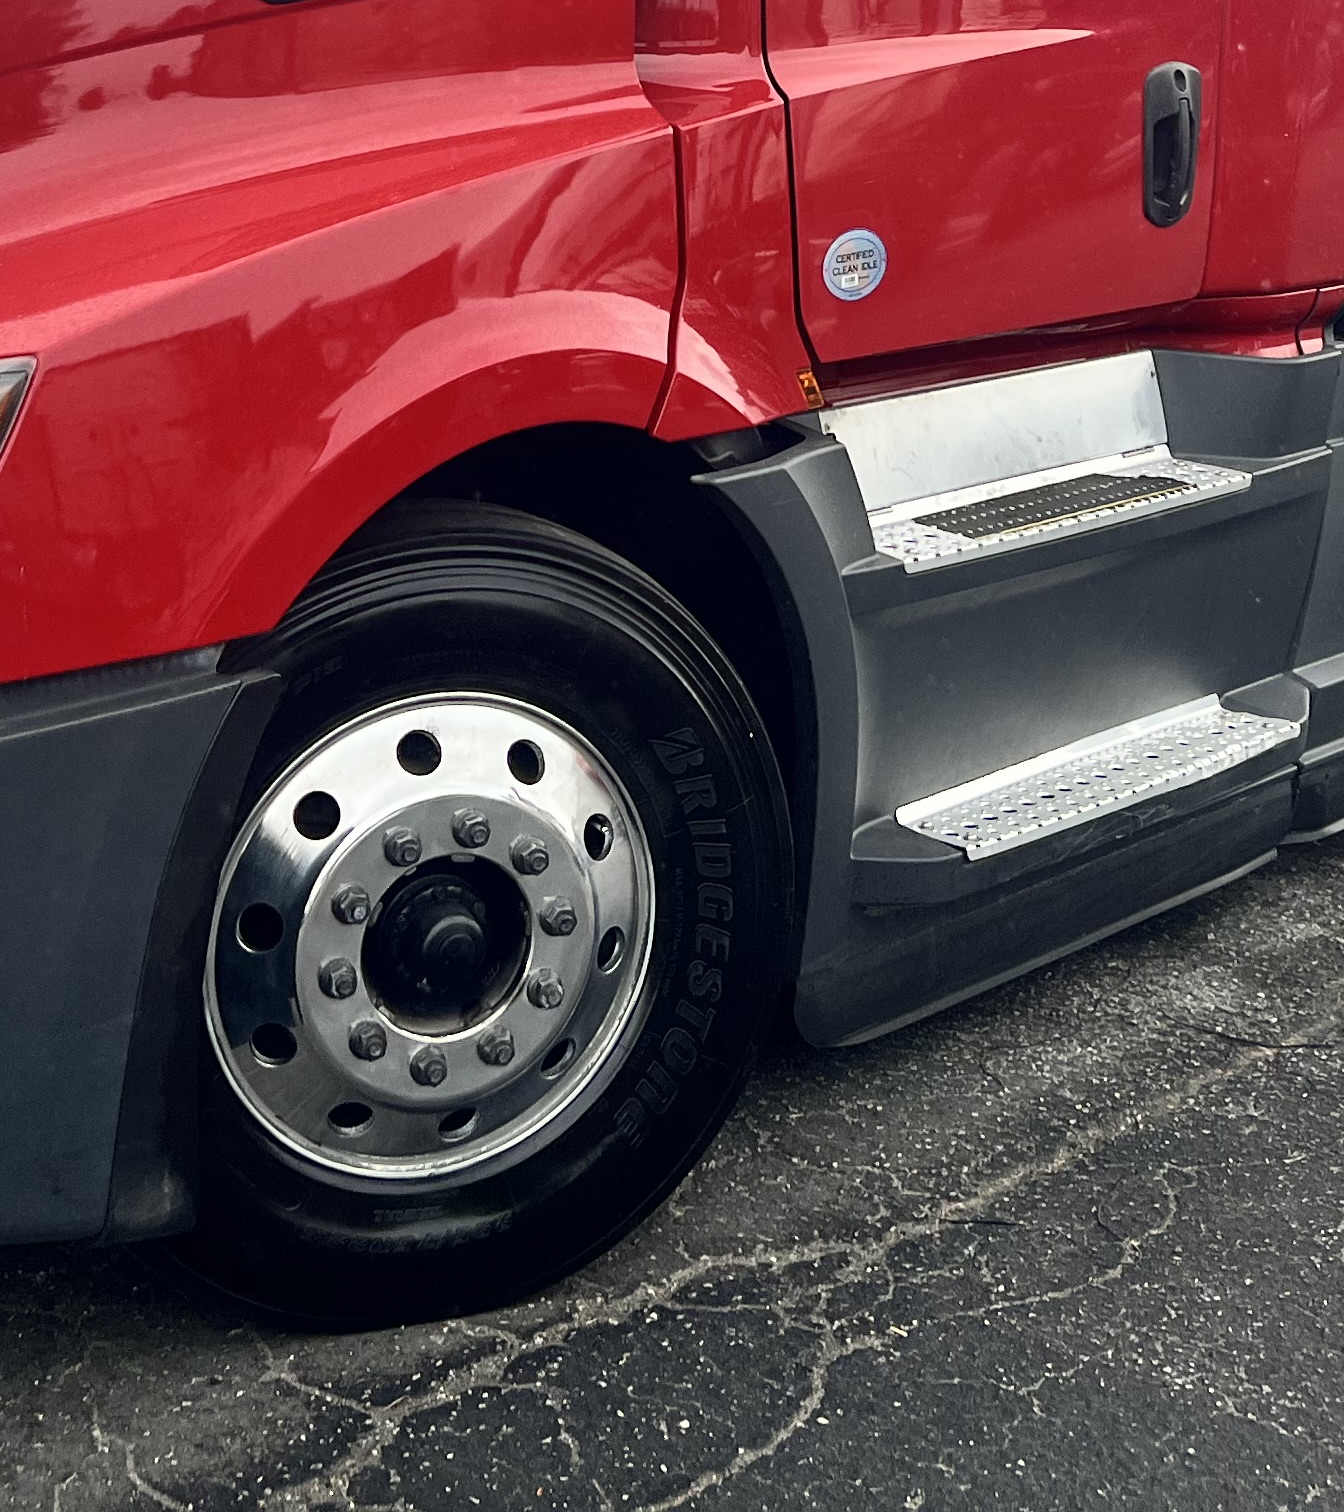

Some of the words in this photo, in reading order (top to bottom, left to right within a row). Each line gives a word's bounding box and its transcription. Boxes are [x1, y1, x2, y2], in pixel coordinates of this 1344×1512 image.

[836, 249, 874, 263] CERTIFIED
[832, 264, 858, 276] CLEAN
[861, 260, 878, 271] IDLE
[612, 727, 735, 1150] BRIDGESTONE
